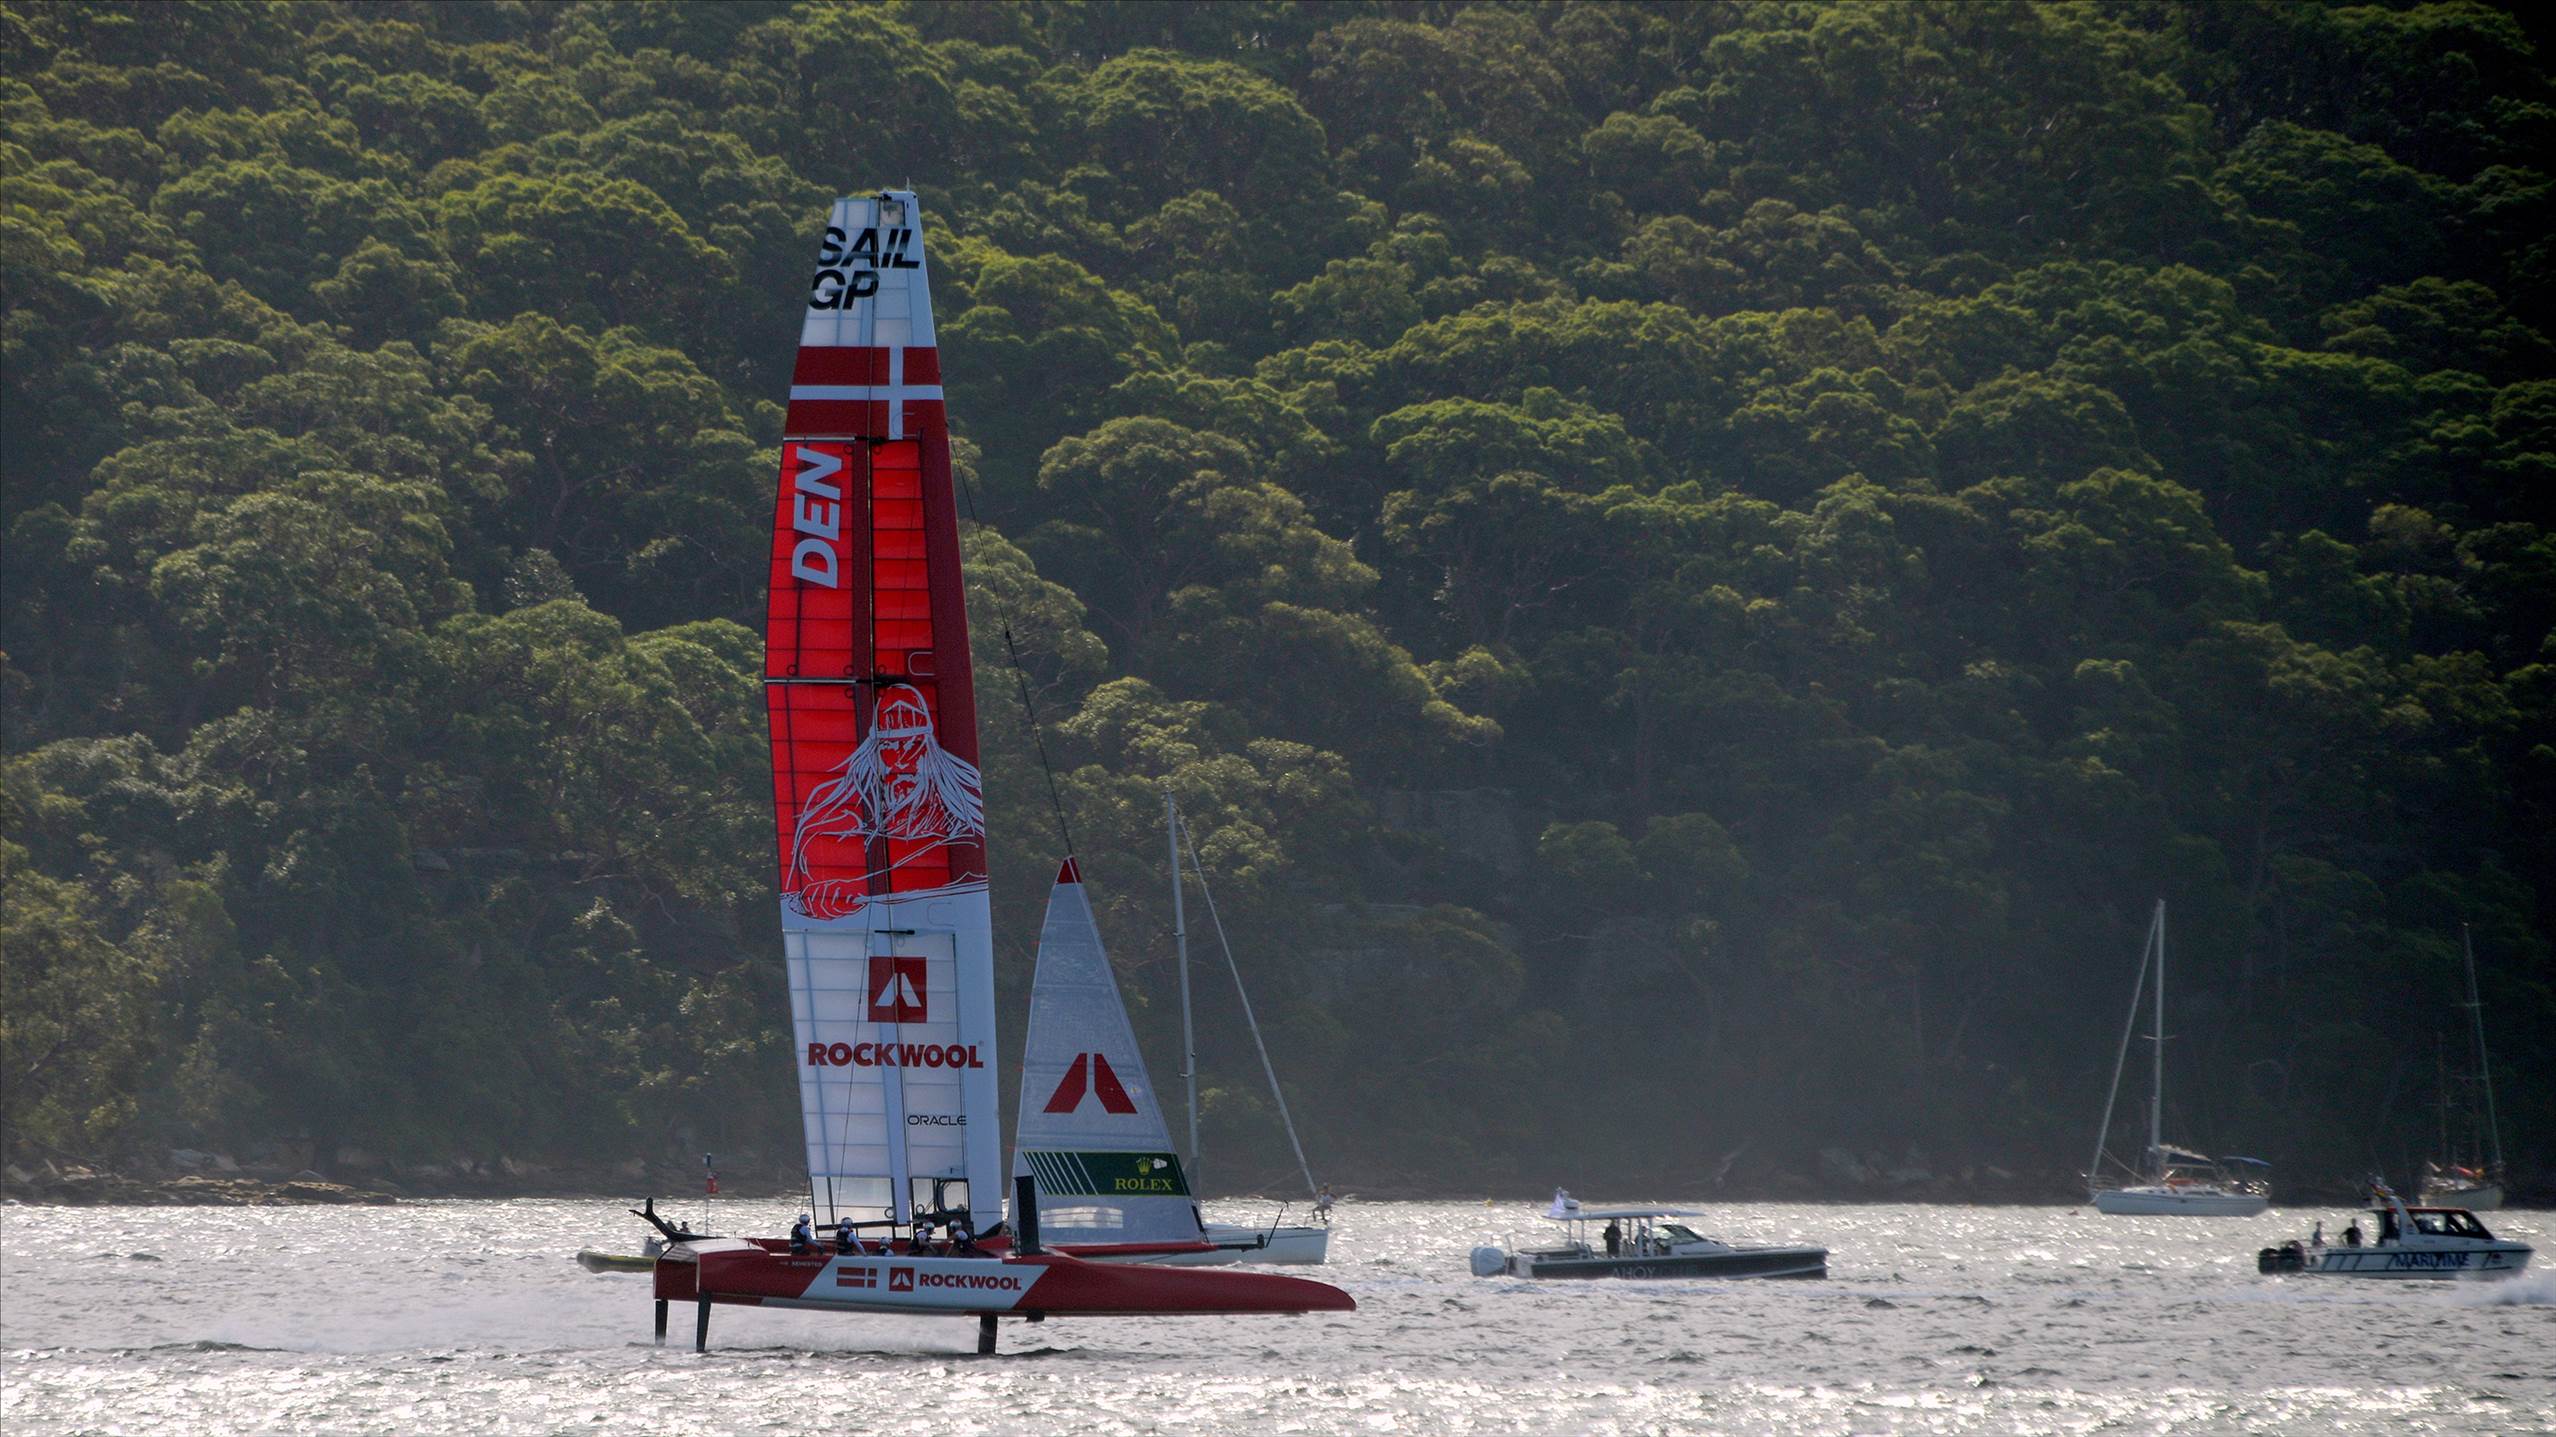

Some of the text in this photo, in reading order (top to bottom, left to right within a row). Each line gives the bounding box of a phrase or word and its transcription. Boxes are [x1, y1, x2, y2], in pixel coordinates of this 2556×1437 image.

[817, 227, 920, 269] SAIL
[808, 270, 880, 310] GP
[791, 446, 843, 589] DEN
[807, 1042, 984, 1068] ROCKWOOL
[907, 1114, 967, 1126] ORACLE
[1115, 1178, 1172, 1191] ROLEX
[919, 1273, 1022, 1290] ROCKWOOL
